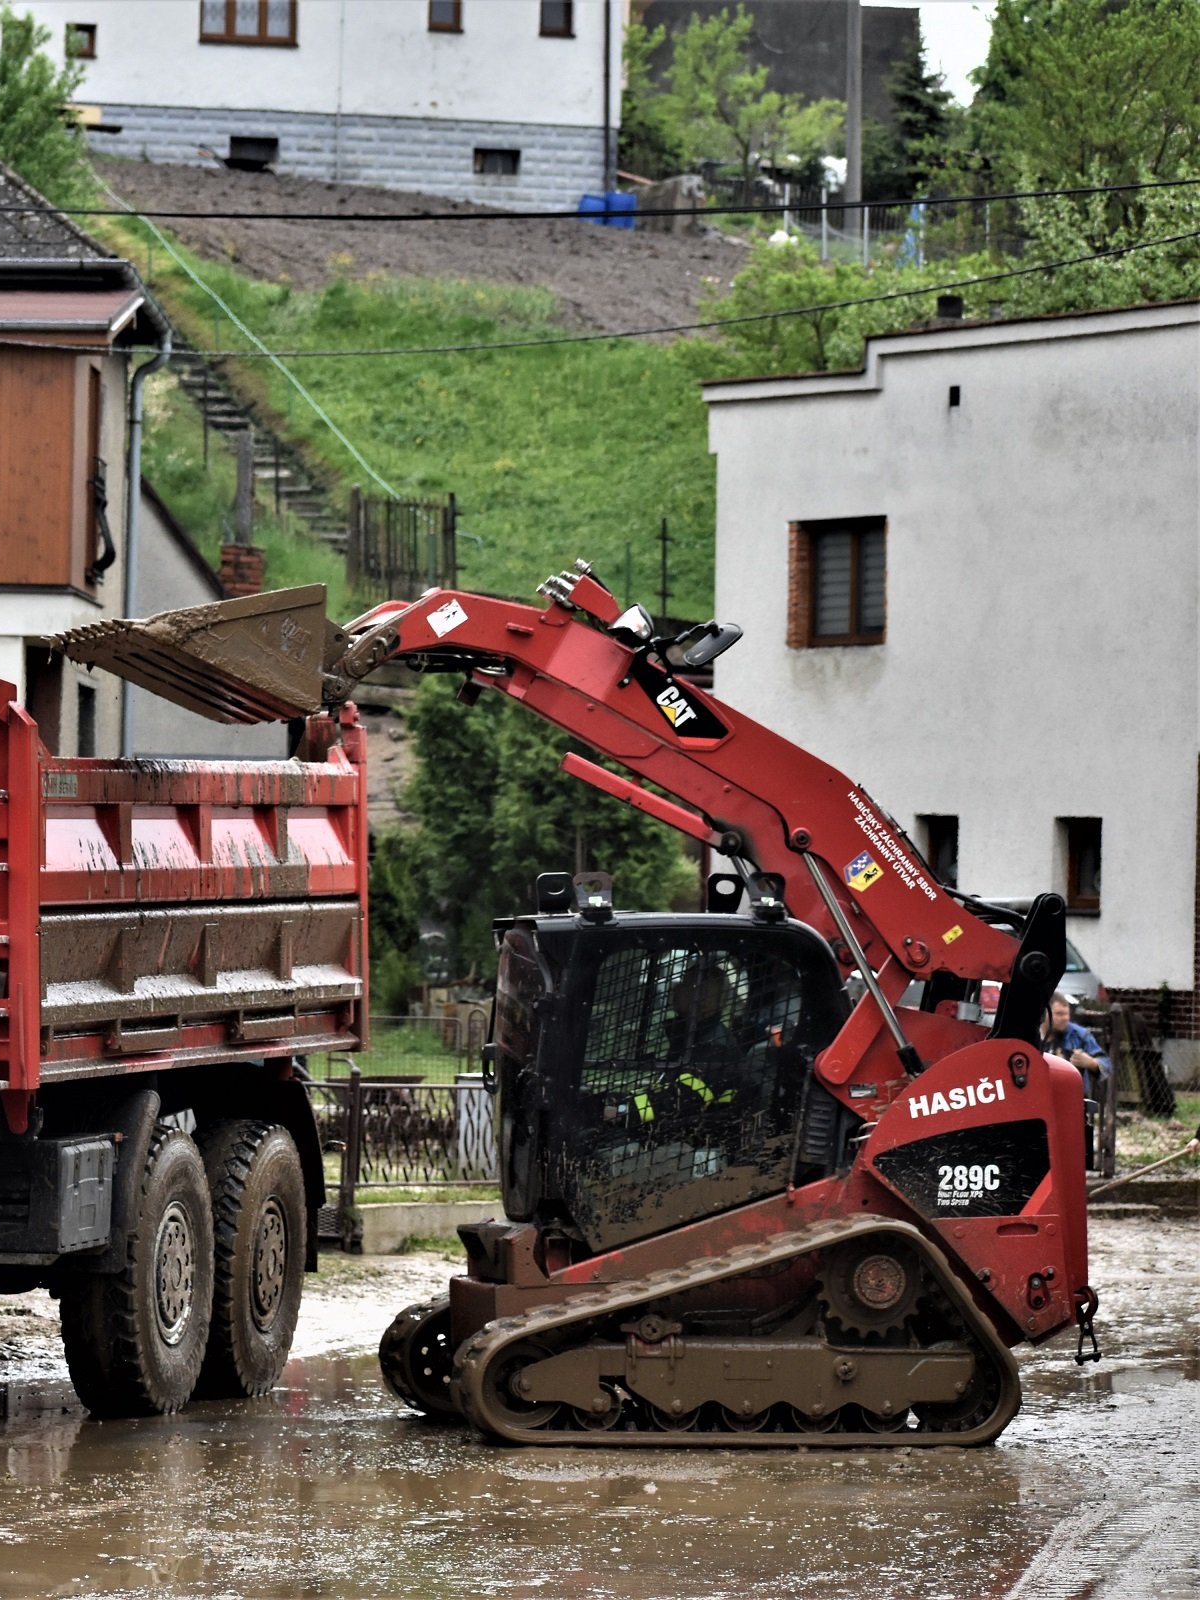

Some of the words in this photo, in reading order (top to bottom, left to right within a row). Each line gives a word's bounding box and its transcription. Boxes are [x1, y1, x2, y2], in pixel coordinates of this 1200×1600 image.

[656, 685, 697, 728] CAT
[847, 791, 882, 830] HASIČSKÝ
[878, 829, 920, 877] ZÁCHRANNÝ
[916, 876, 937, 901] SBOR
[854, 814, 895, 863] ZÁCHRANNÝ
[892, 861, 916, 890] ÚTVAR
[908, 1077, 1006, 1119] HASIČI
[938, 1164, 1000, 1191] 289C
[969, 1190, 984, 1198] XPS
